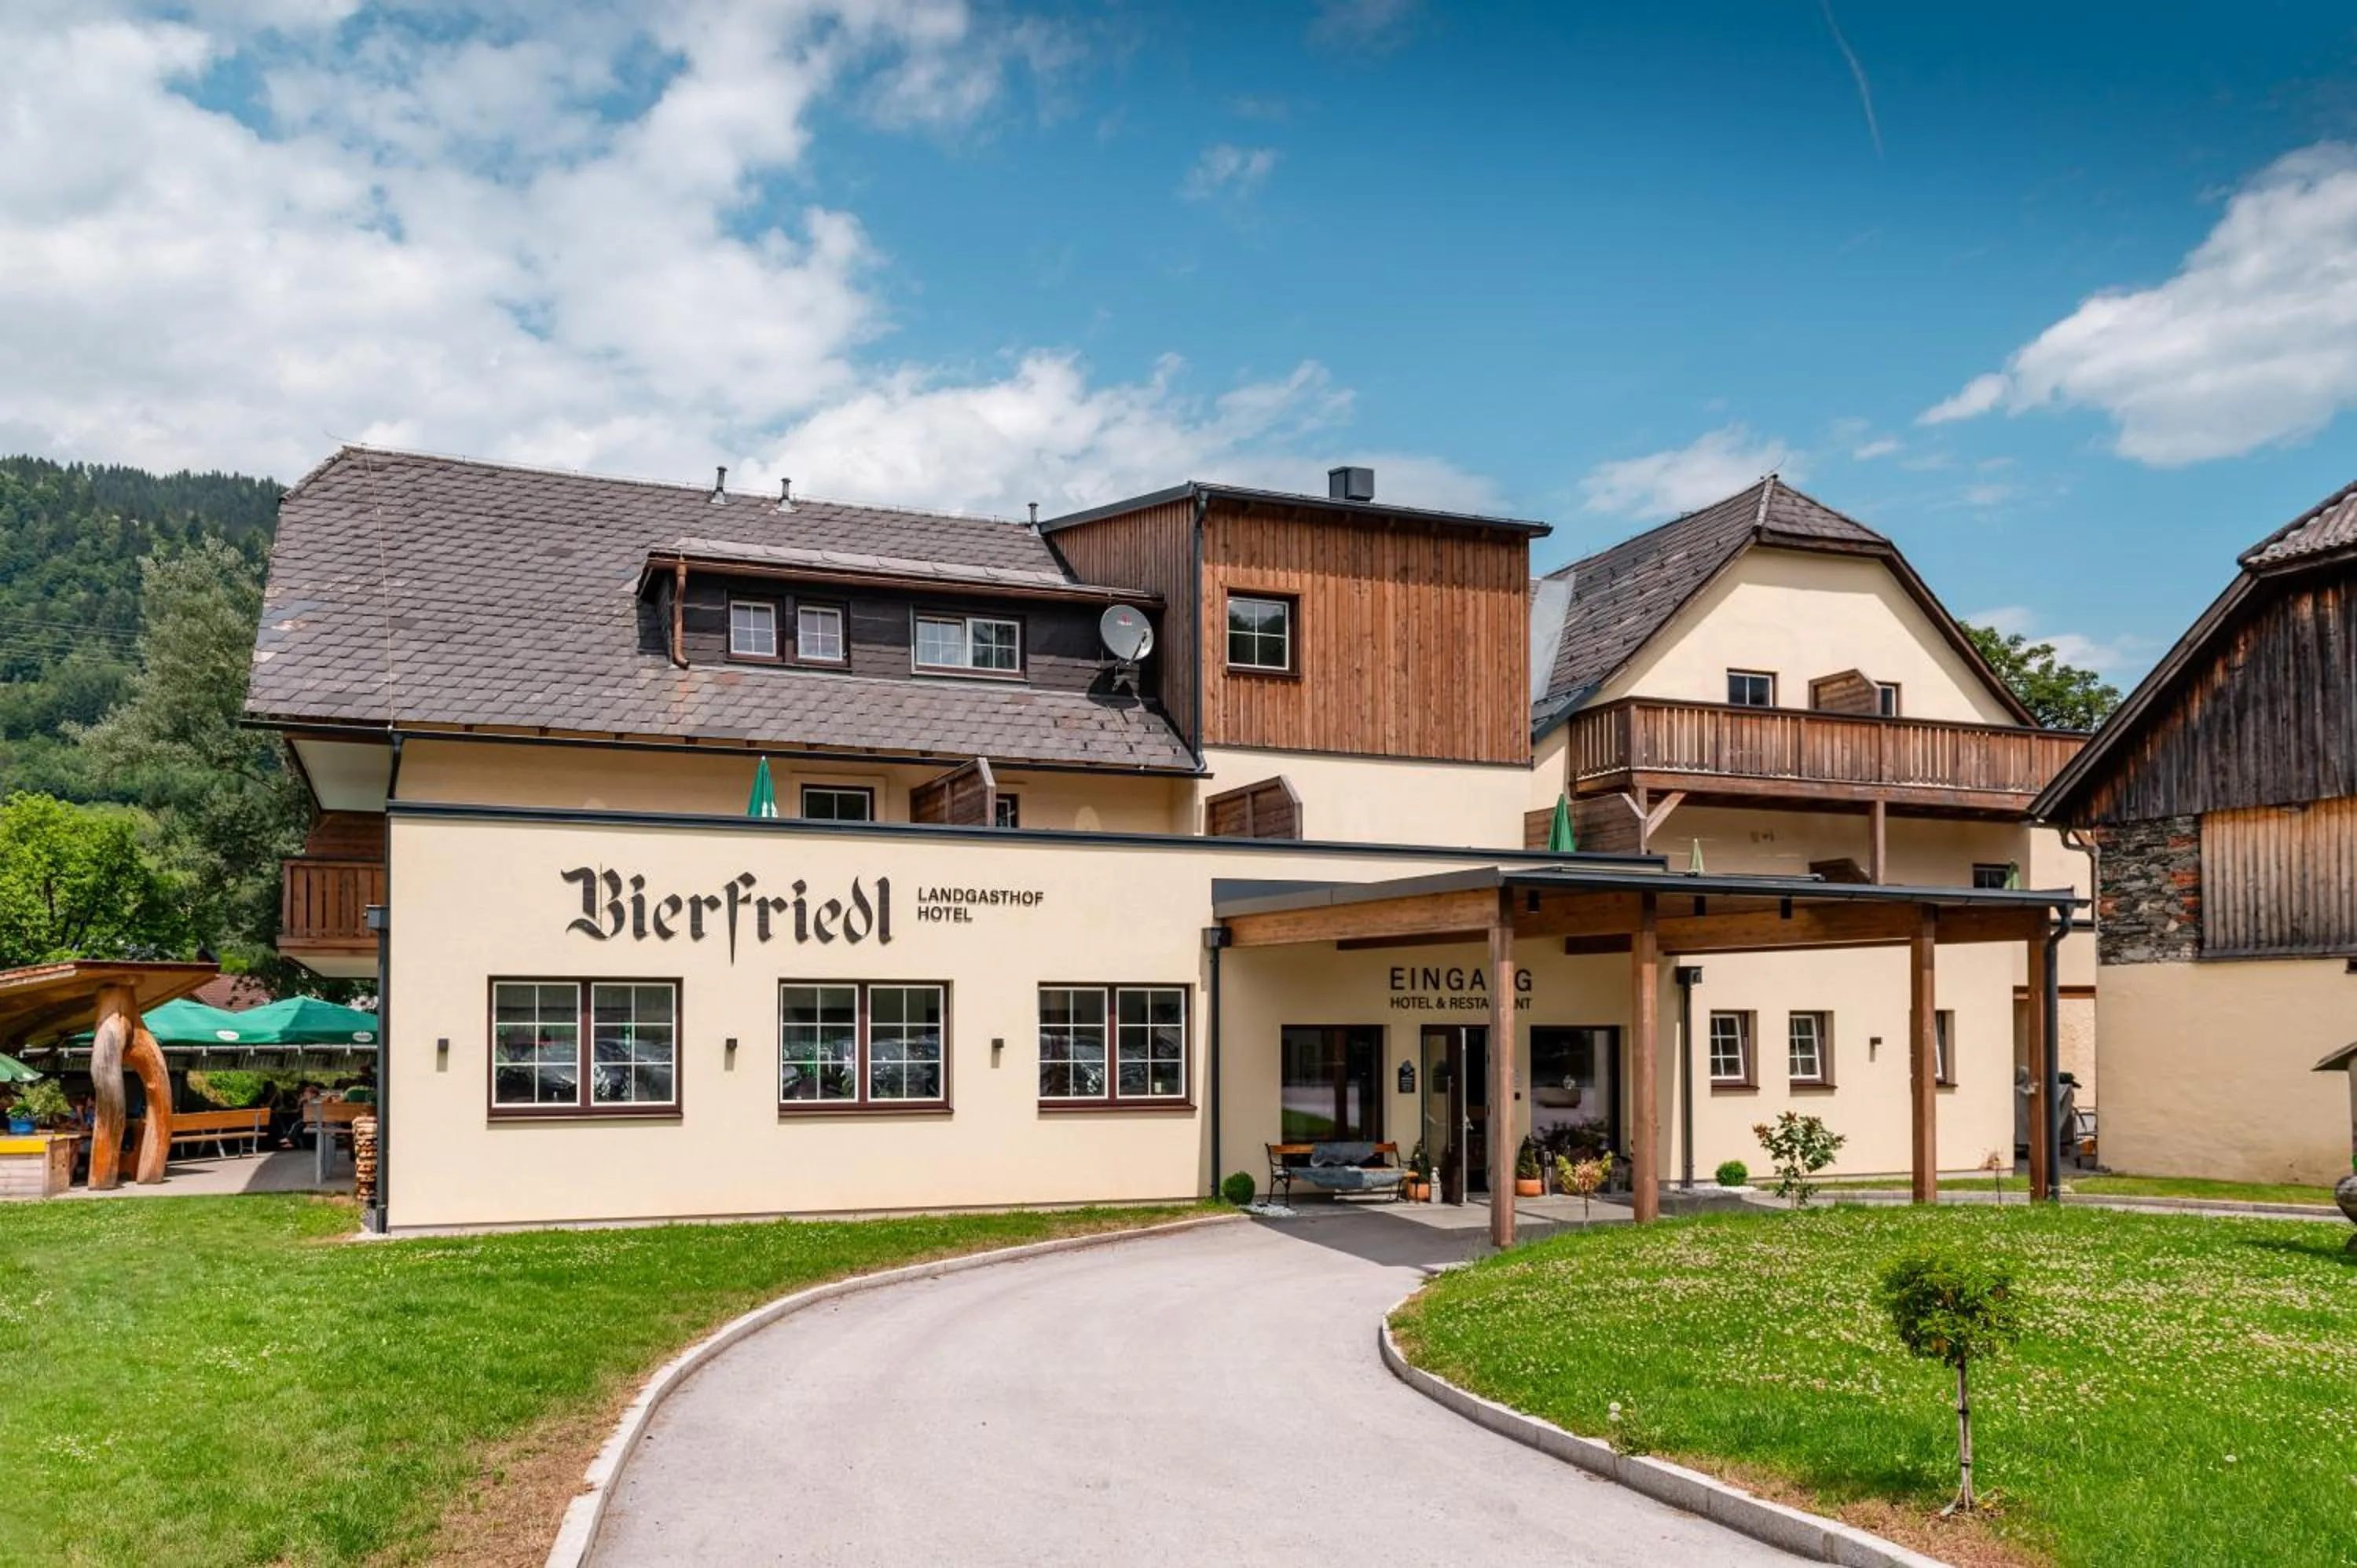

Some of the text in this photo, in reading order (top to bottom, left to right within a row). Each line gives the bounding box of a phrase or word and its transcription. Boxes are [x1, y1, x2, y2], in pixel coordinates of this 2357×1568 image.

[918, 887, 1044, 907] LANDGASTHOF
[560, 863, 893, 967] Bierfriedl
[918, 906, 973, 922] HOTEL
[1390, 967, 1531, 991] EINGAG
[1391, 997, 1531, 1009] HOTEL & RESTANT
